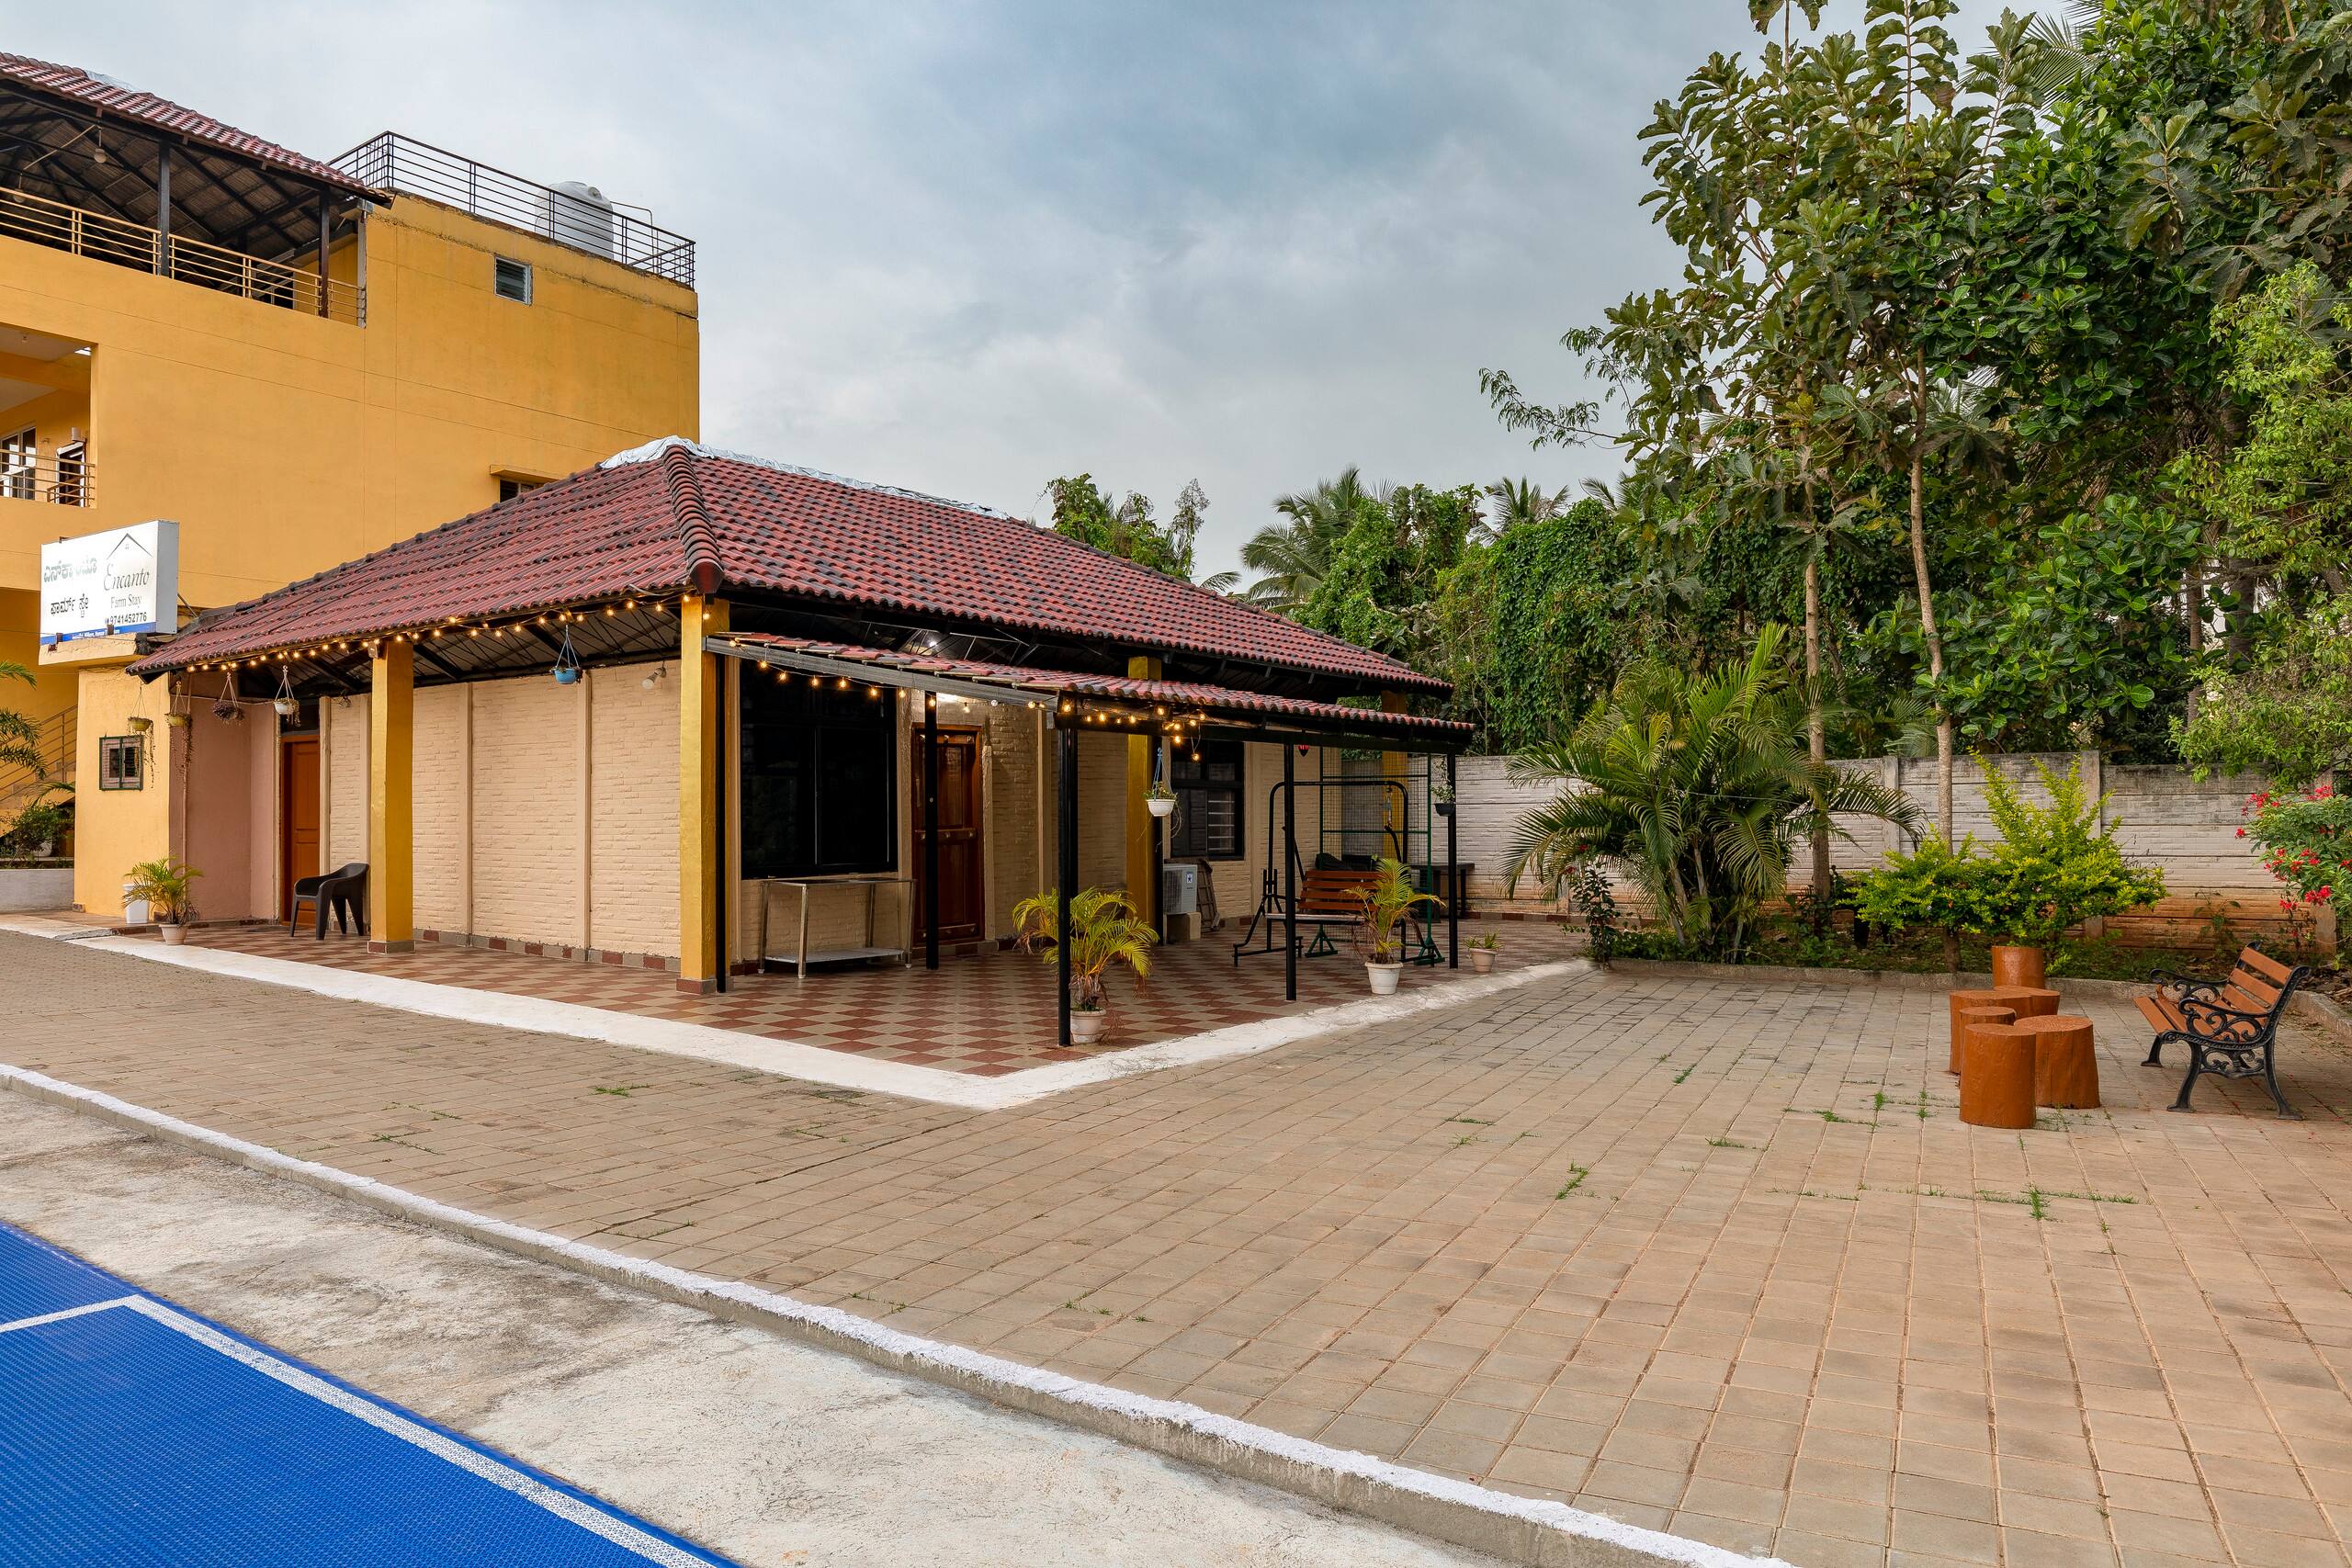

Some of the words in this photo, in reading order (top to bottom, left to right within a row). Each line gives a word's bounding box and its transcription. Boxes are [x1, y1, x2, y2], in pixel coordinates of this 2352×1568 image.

[104, 563, 150, 591] Encanto
[110, 596, 127, 608] Farm
[129, 593, 142, 608] Stay
[110, 612, 147, 625] 9741452776
